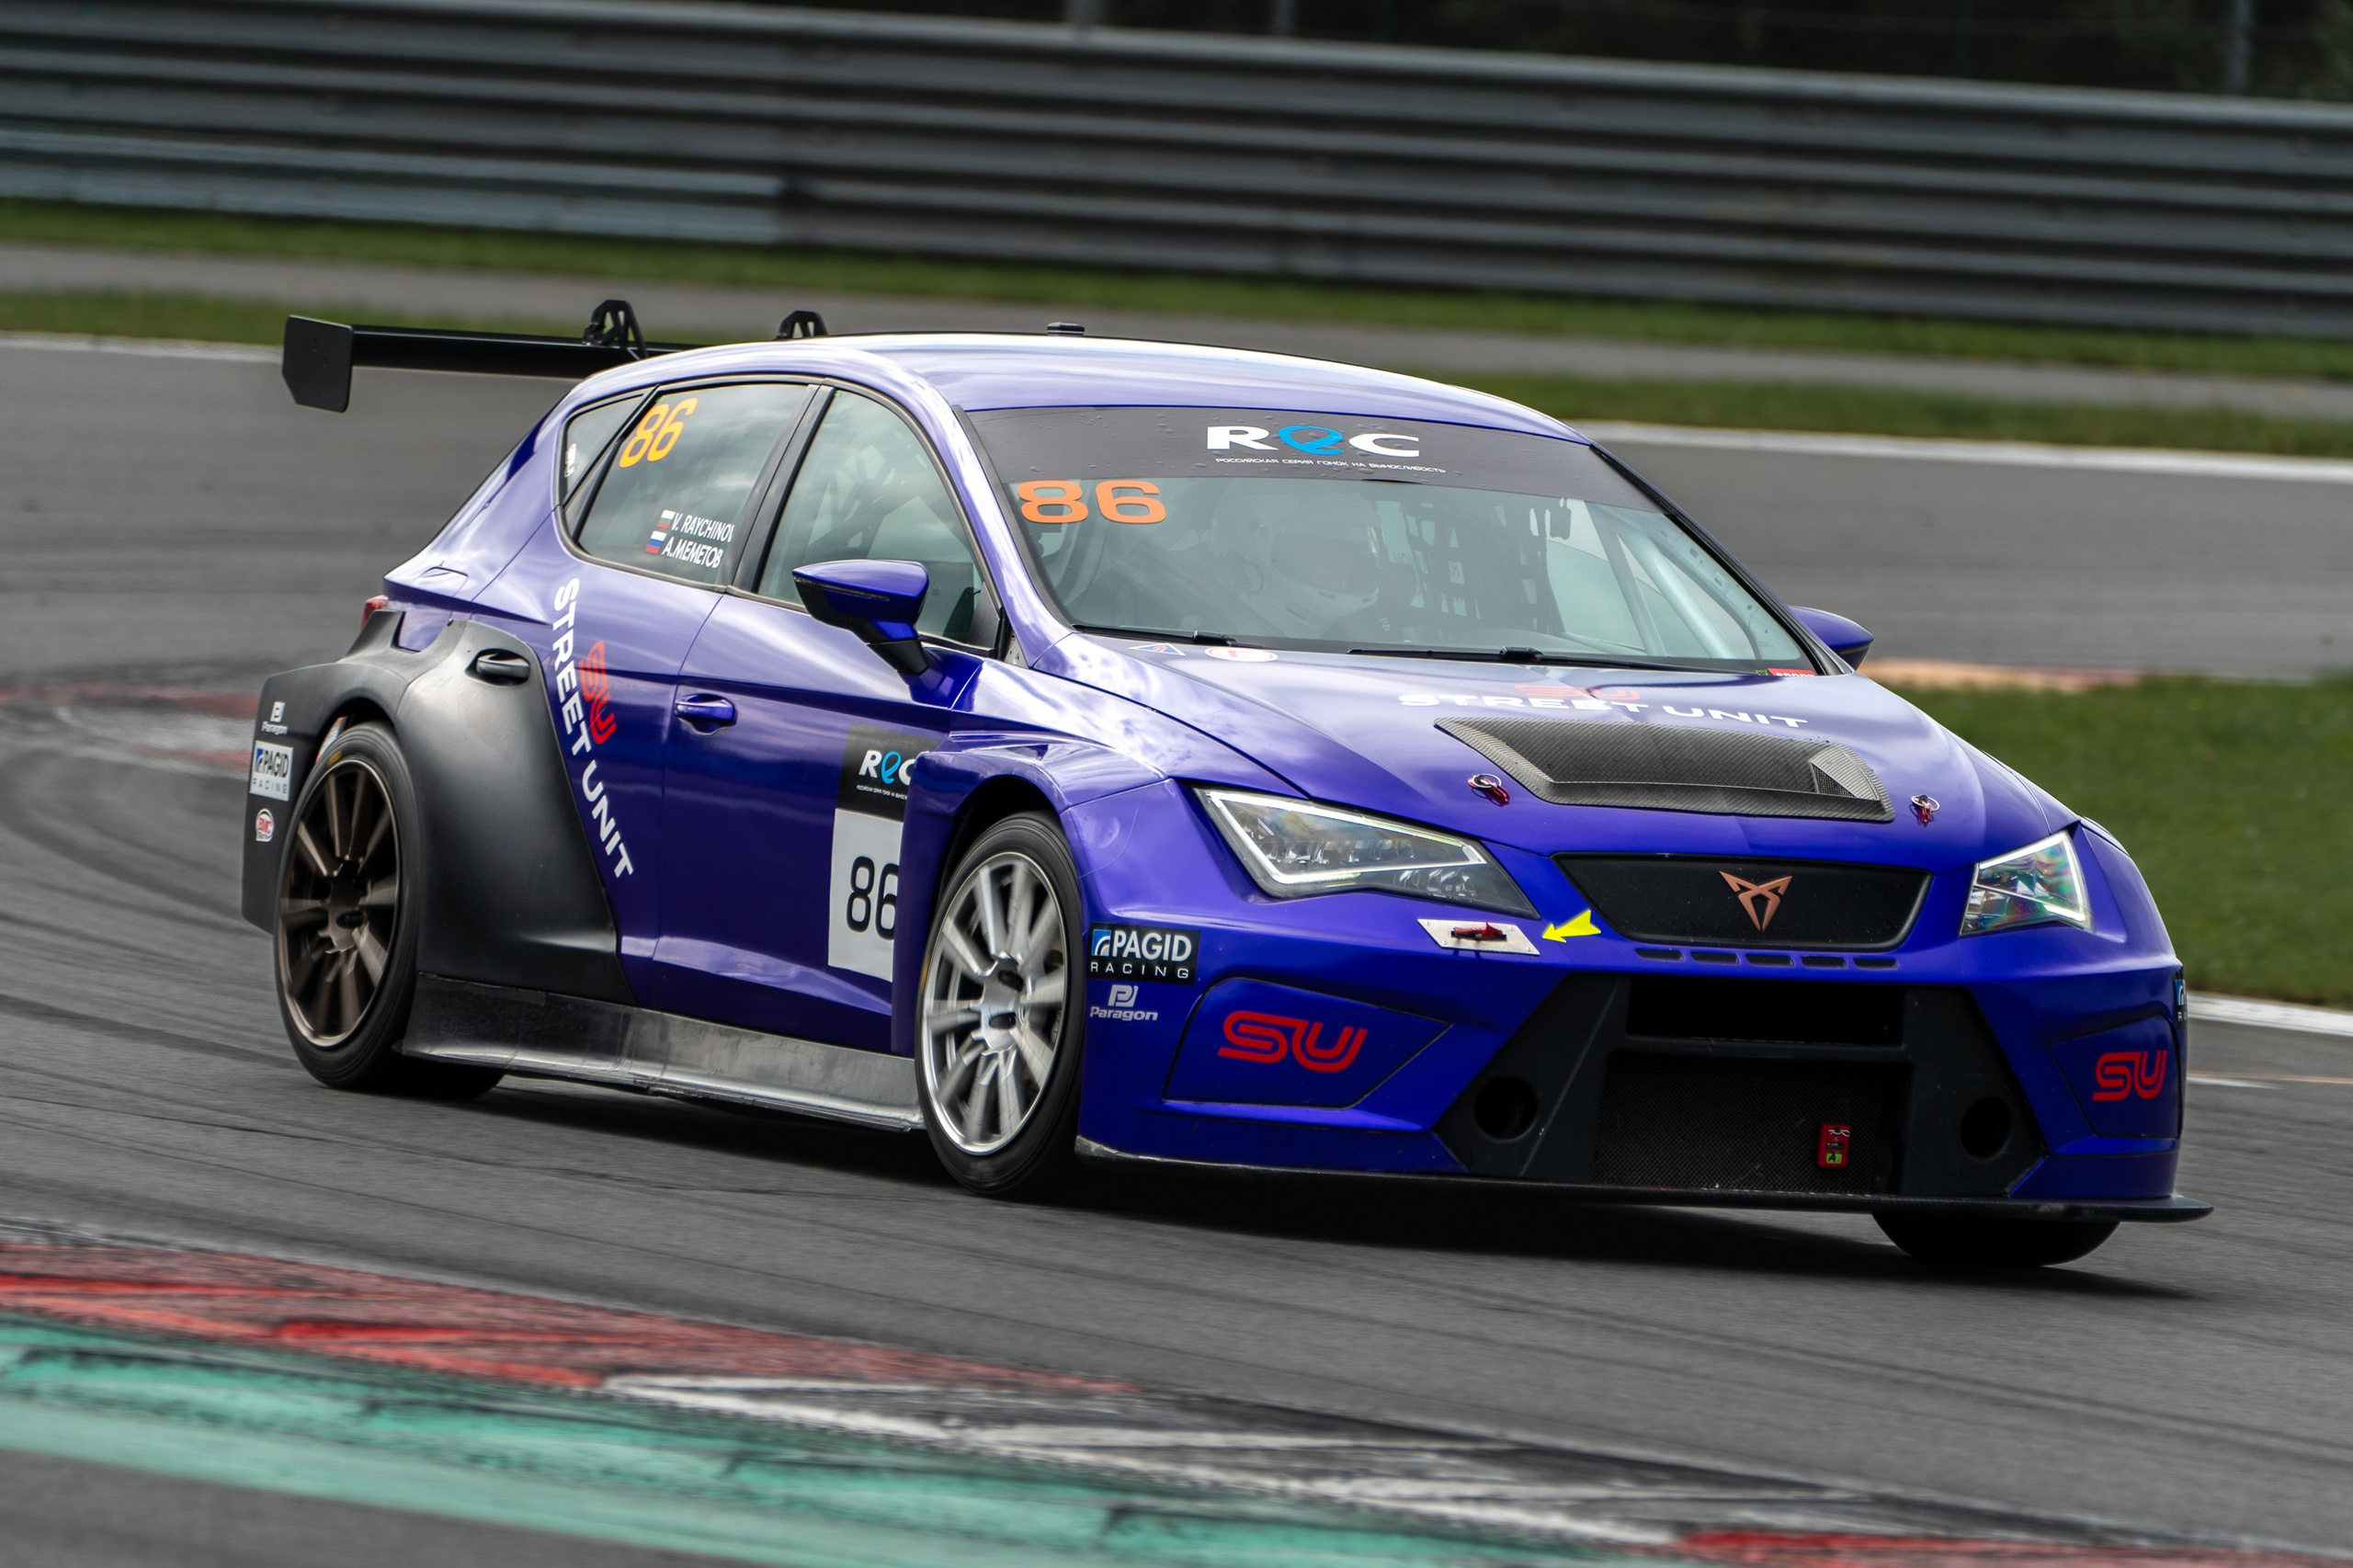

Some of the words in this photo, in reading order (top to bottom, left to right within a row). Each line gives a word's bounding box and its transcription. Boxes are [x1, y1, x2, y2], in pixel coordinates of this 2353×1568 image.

[619, 397, 699, 468] 86
[1369, 462, 1447, 473] ВЫНОСЛИВОСТЬ
[1017, 480, 1166, 524] 86
[671, 512, 684, 531] V.
[552, 577, 592, 756] STREET
[582, 759, 634, 879] UNIT
[1398, 694, 1649, 715] STREET
[1662, 704, 1809, 729] UNIT
[261, 749, 290, 778] PAGID
[846, 855, 900, 940] 86
[1110, 928, 1192, 962] PAGID
[1090, 961, 1189, 980] RACING
[1090, 1006, 1159, 1022] Paragon
[1218, 1009, 1369, 1073] SU
[2092, 1050, 2167, 1101] SU
